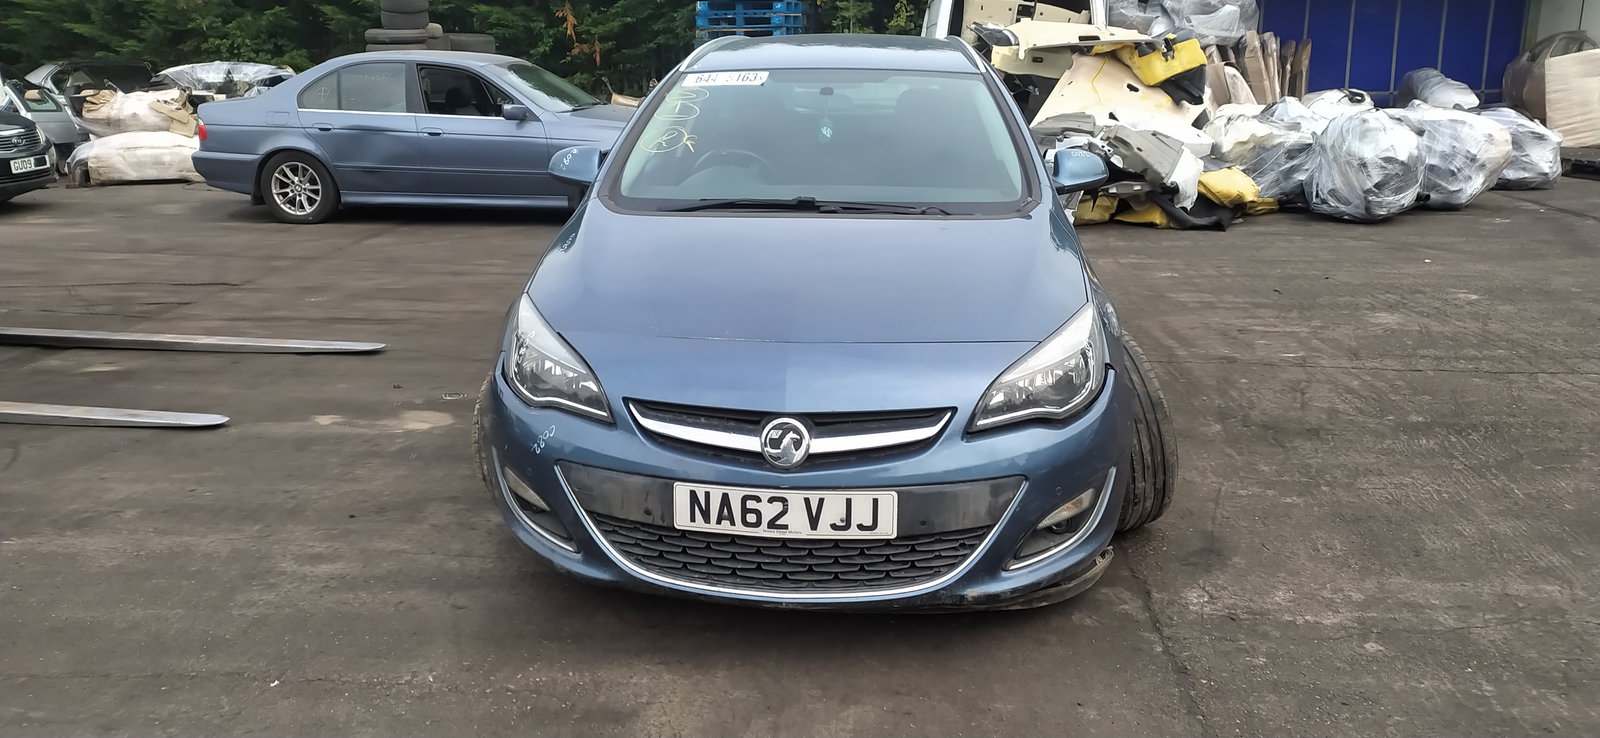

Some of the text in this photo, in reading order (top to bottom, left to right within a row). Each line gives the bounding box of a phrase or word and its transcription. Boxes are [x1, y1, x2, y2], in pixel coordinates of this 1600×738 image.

[13, 159, 32, 171] GU09
[689, 489, 879, 532] NA62 VJJ
